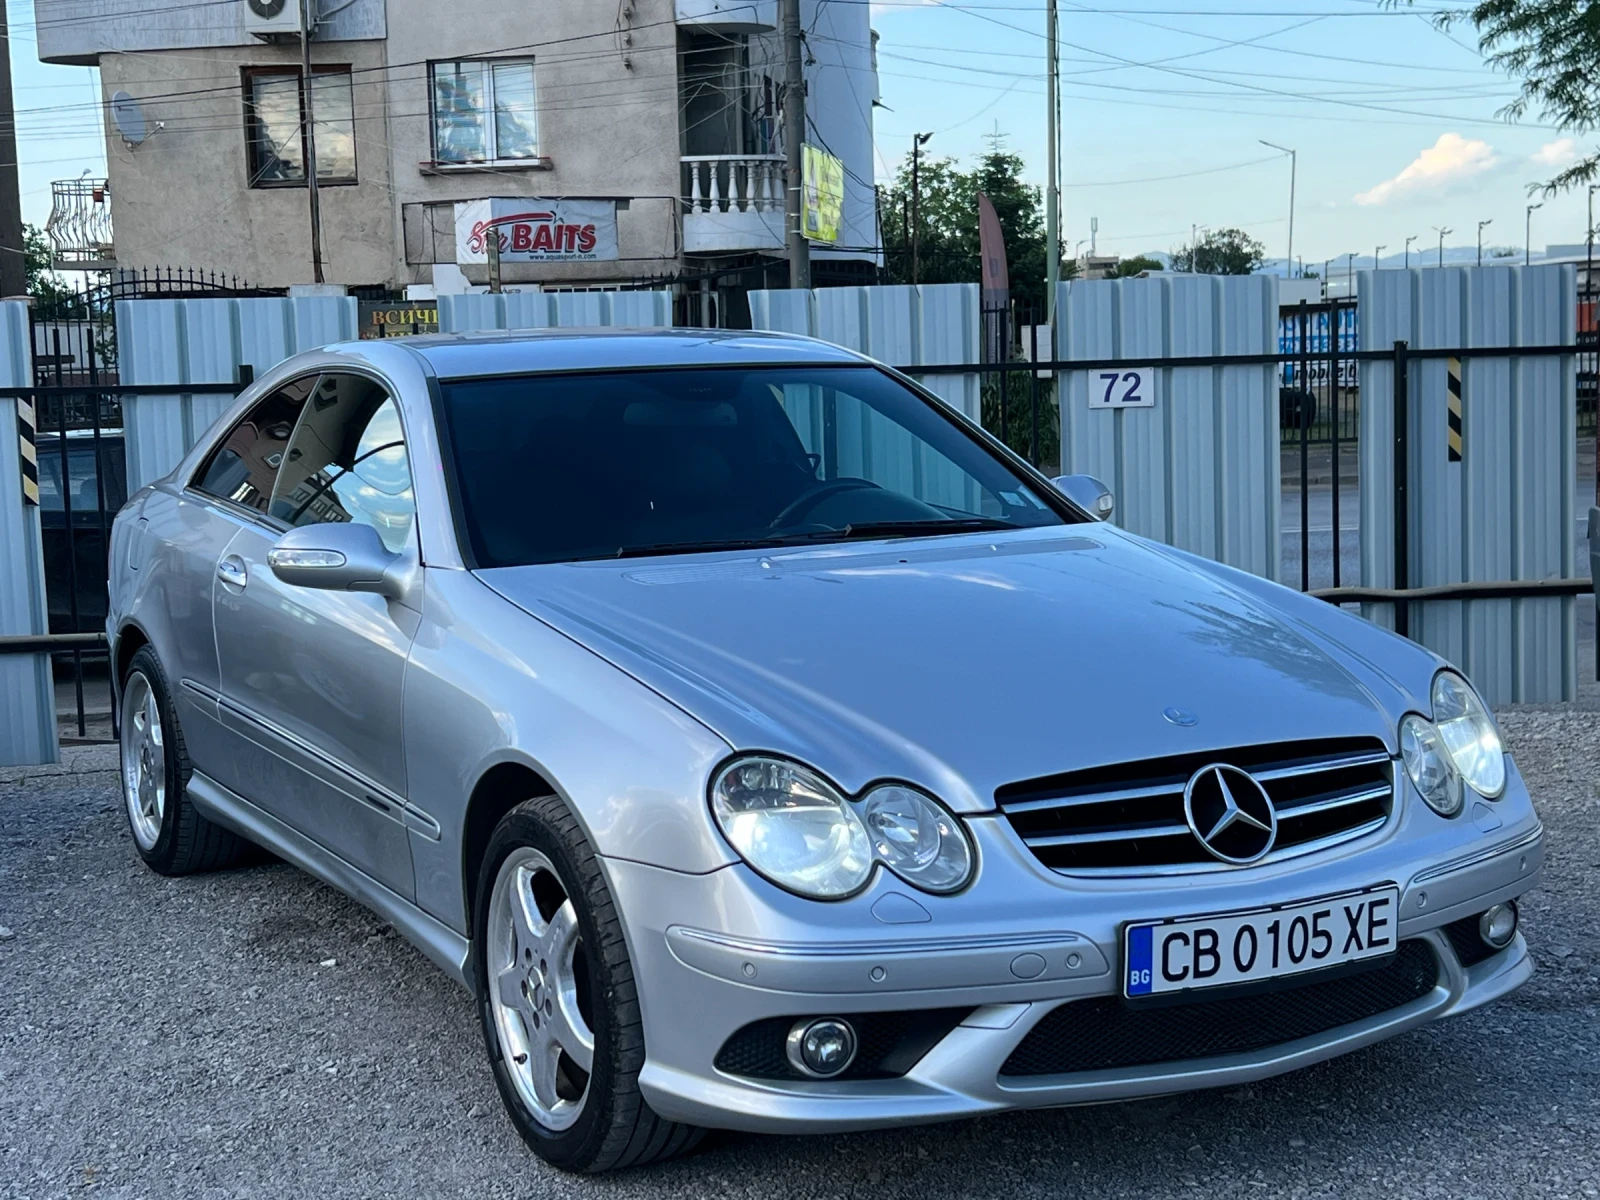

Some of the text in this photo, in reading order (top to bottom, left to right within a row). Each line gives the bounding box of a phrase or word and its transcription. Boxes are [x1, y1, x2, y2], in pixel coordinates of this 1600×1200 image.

[511, 223, 597, 253] BAITS
[1100, 372, 1142, 402] 72
[1161, 897, 1390, 982] CB 0105 XE
[1130, 969, 1150, 986] BG
